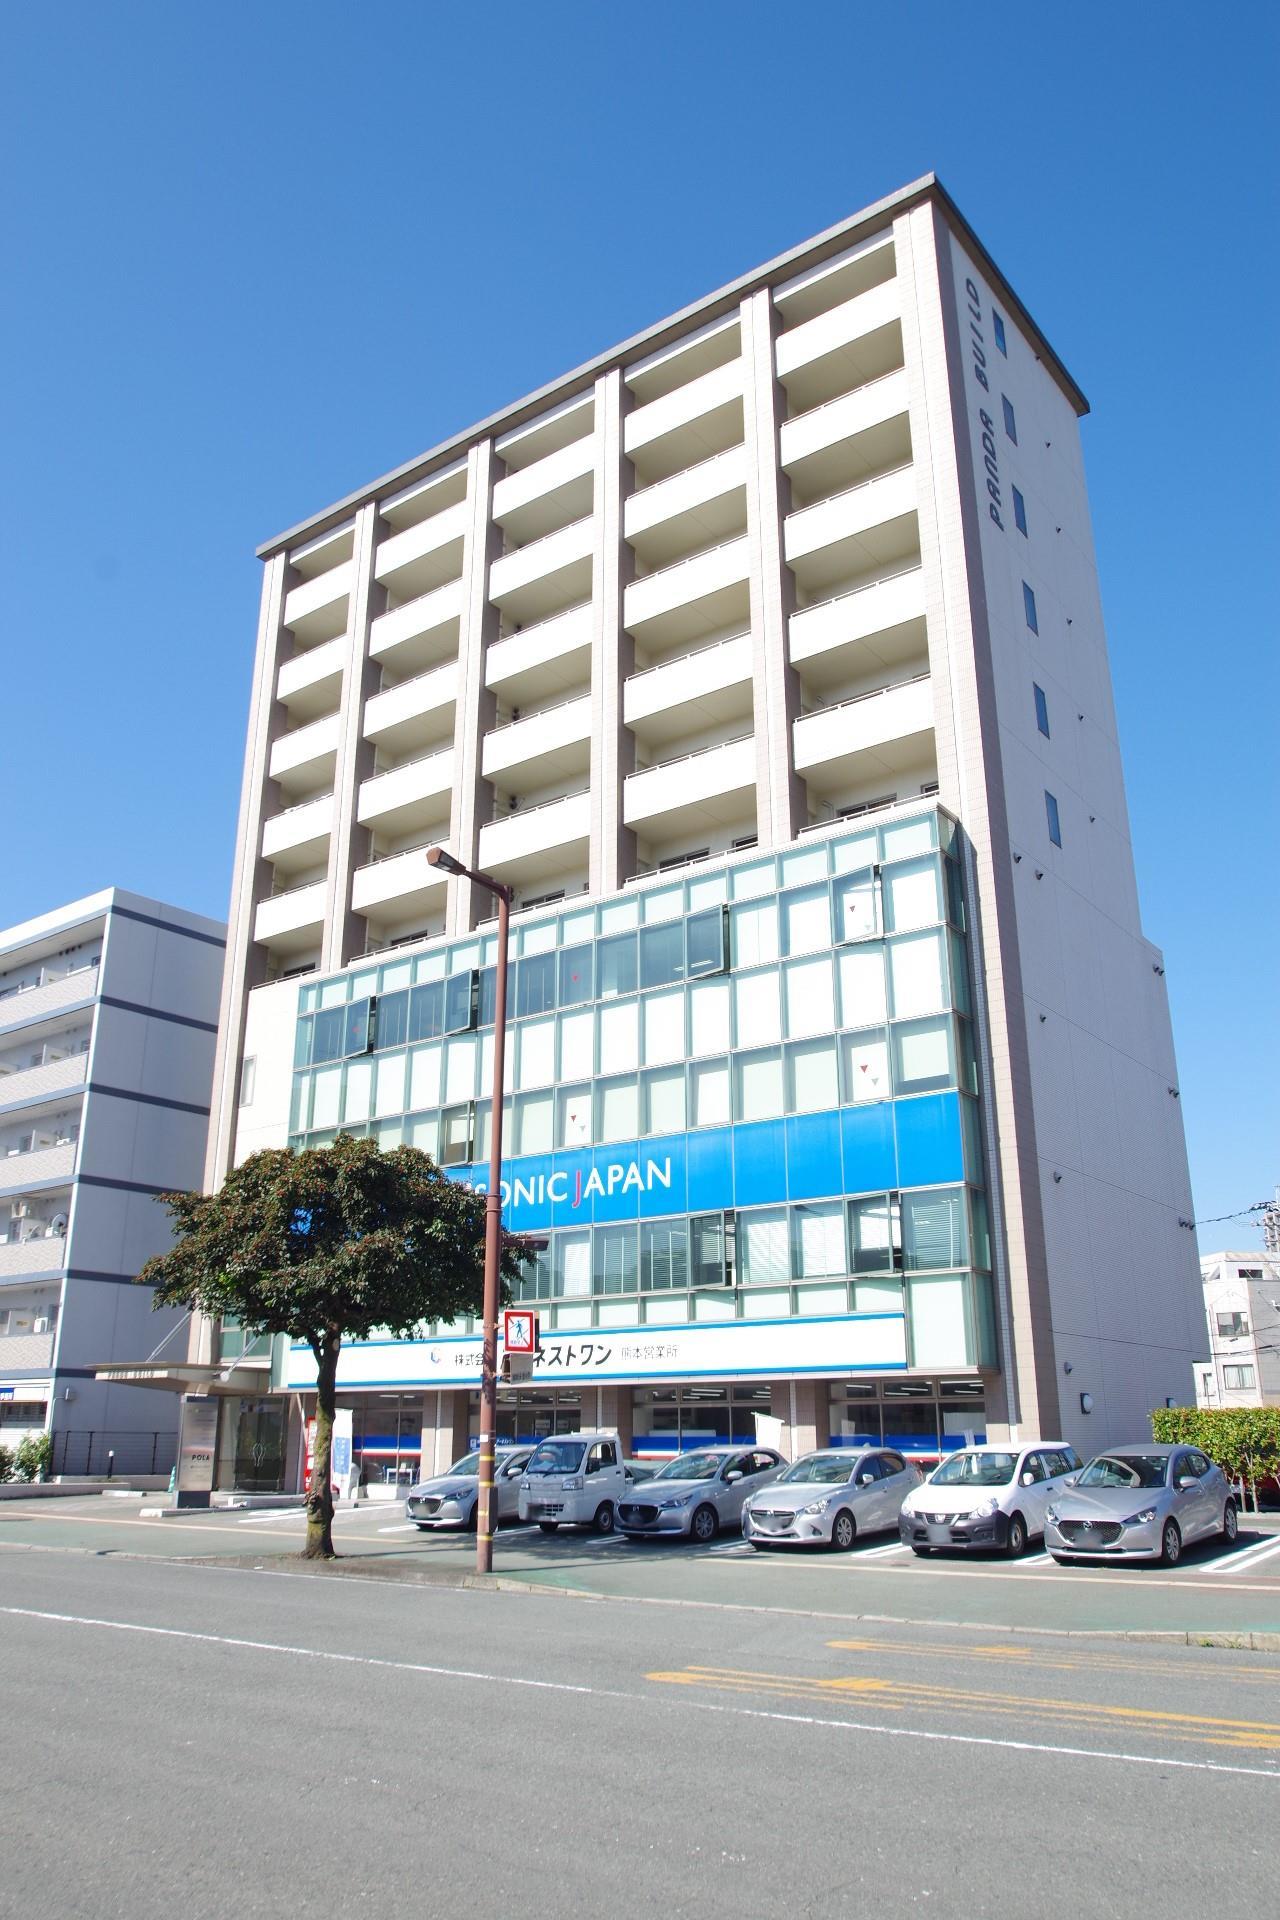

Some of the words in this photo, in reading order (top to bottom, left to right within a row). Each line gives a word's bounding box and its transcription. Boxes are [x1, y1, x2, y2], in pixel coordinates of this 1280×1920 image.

[965, 277, 990, 393] BUILD
[979, 407, 1004, 532] PANDA
[571, 1157, 671, 1209] JAPAN
[455, 1353, 484, 1366] 株式会
[533, 1344, 612, 1368] ネストワン
